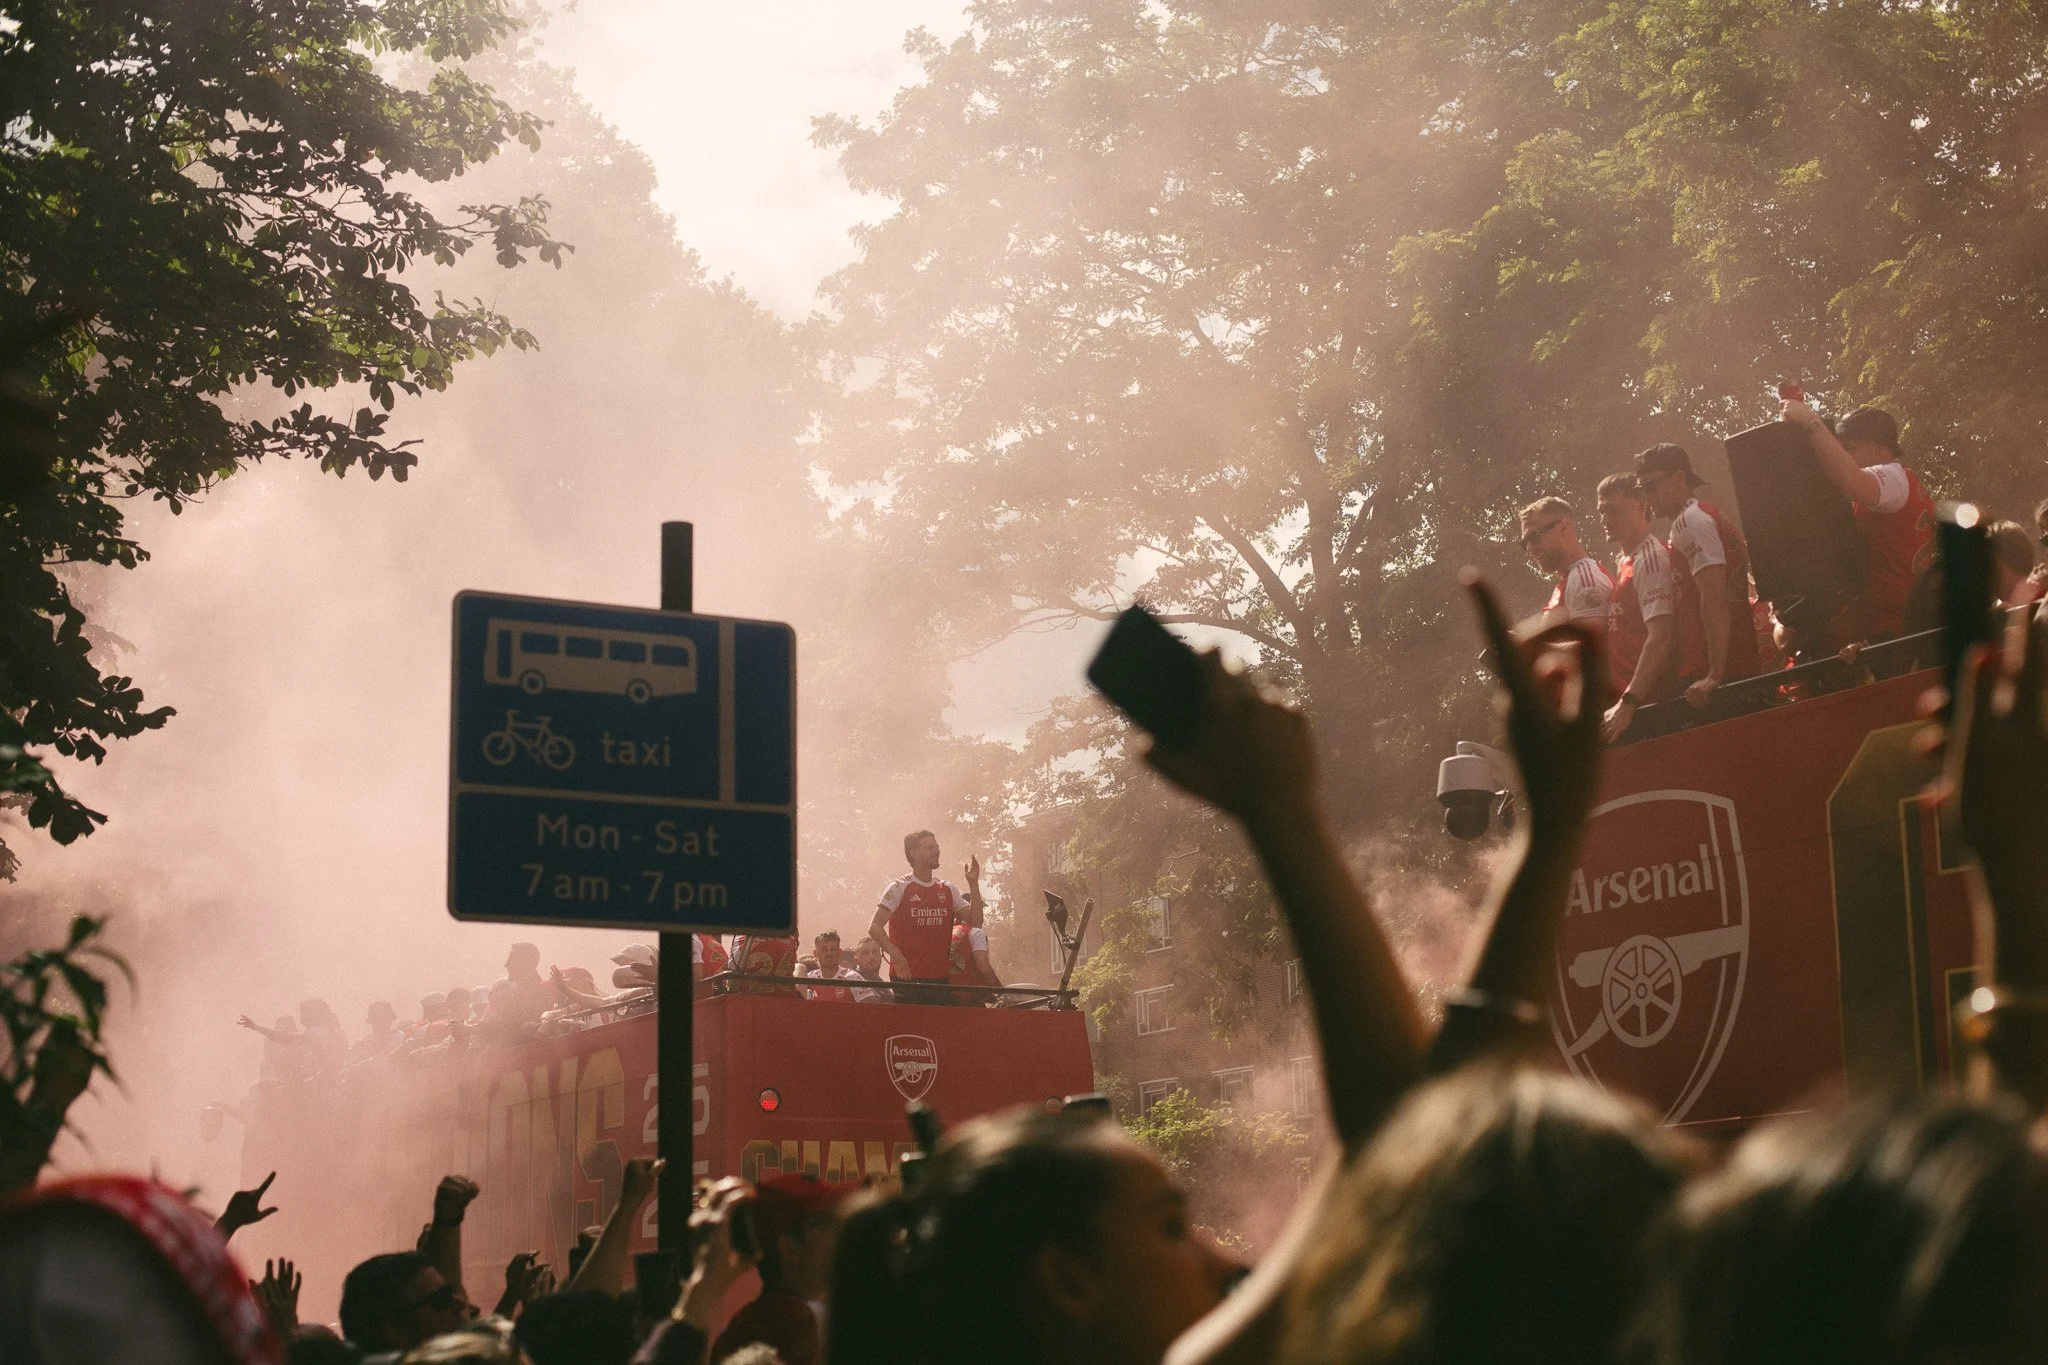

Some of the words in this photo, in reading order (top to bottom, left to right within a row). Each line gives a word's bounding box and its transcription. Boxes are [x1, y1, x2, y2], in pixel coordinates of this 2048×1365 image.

[602, 731, 671, 767] taxi
[536, 814, 620, 850] Mon
[655, 821, 721, 857] Sat
[1564, 843, 1715, 917] Arsenal
[910, 906, 948, 917] Emirates
[892, 1046, 930, 1057] Arsenal
